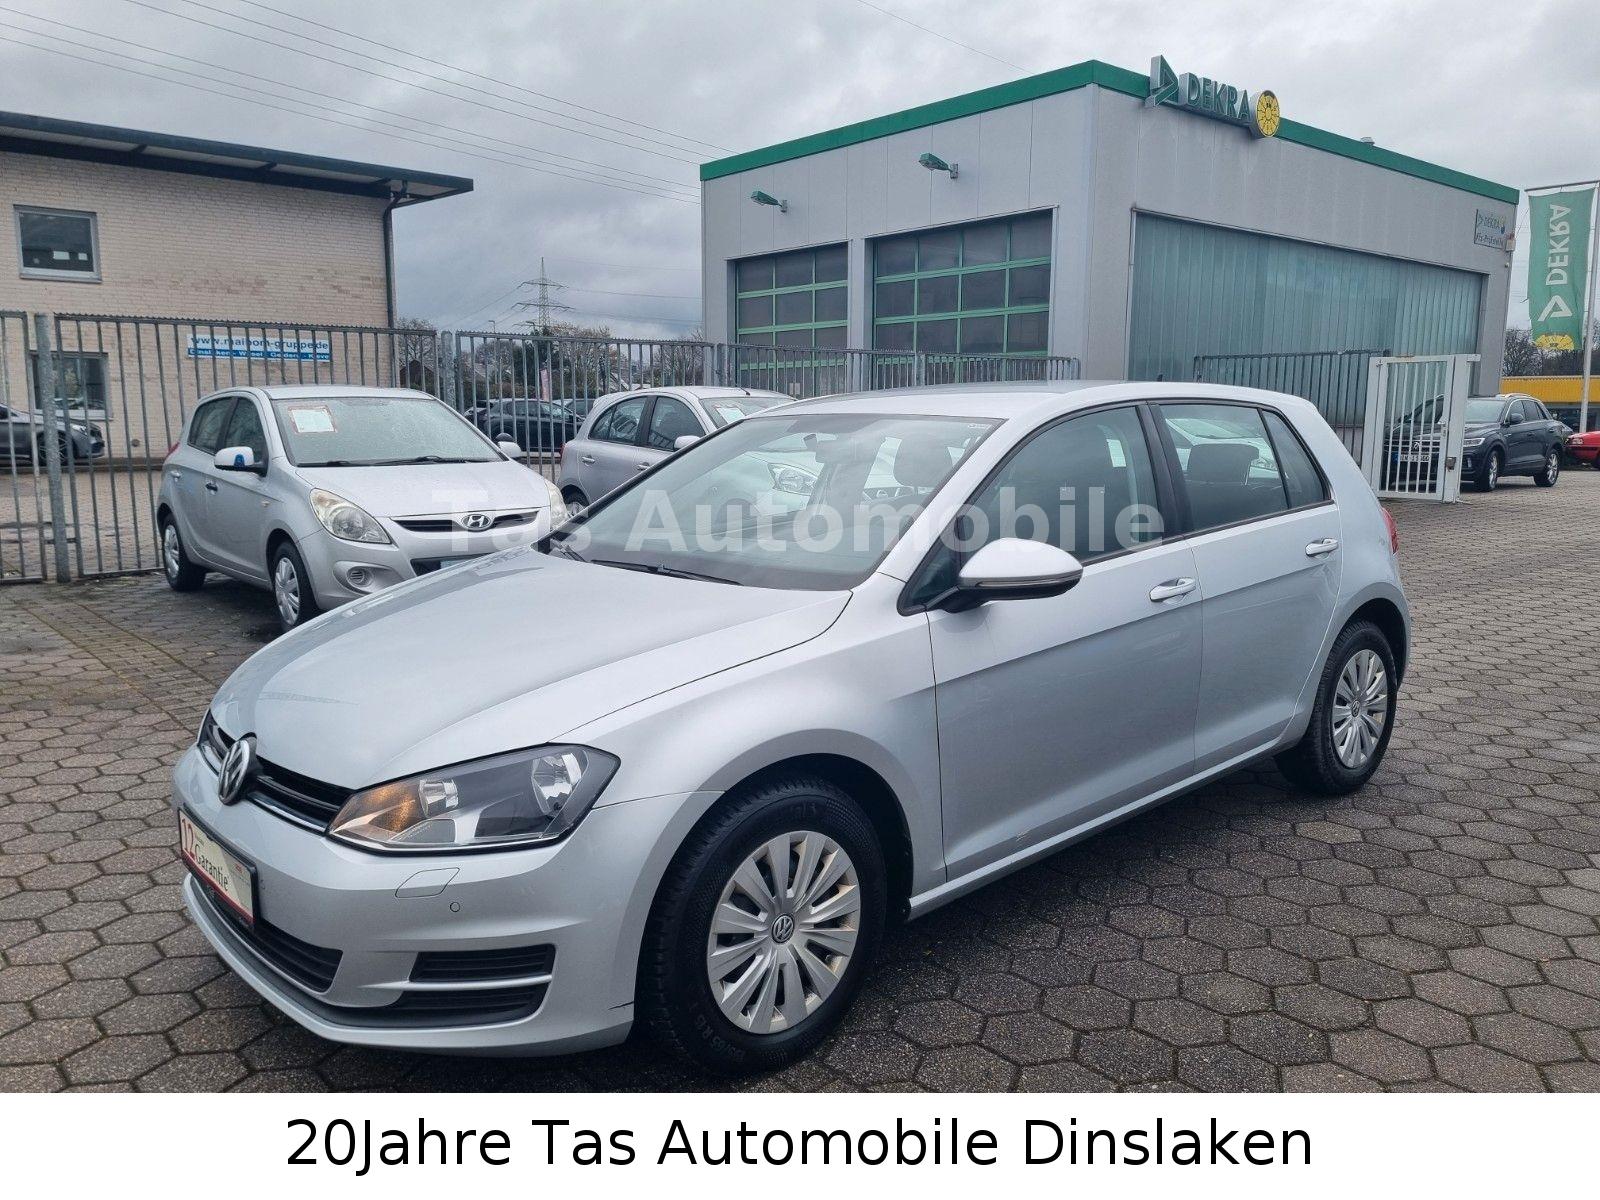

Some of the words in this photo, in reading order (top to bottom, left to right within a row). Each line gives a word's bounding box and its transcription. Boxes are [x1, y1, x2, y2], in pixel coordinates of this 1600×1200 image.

[1180, 71, 1250, 121] DEKRA
[1546, 204, 1571, 286] DEKRA
[191, 337, 329, 350] www.maiom-gruppede
[181, 818, 196, 860] 12
[194, 844, 229, 892] Garantie
